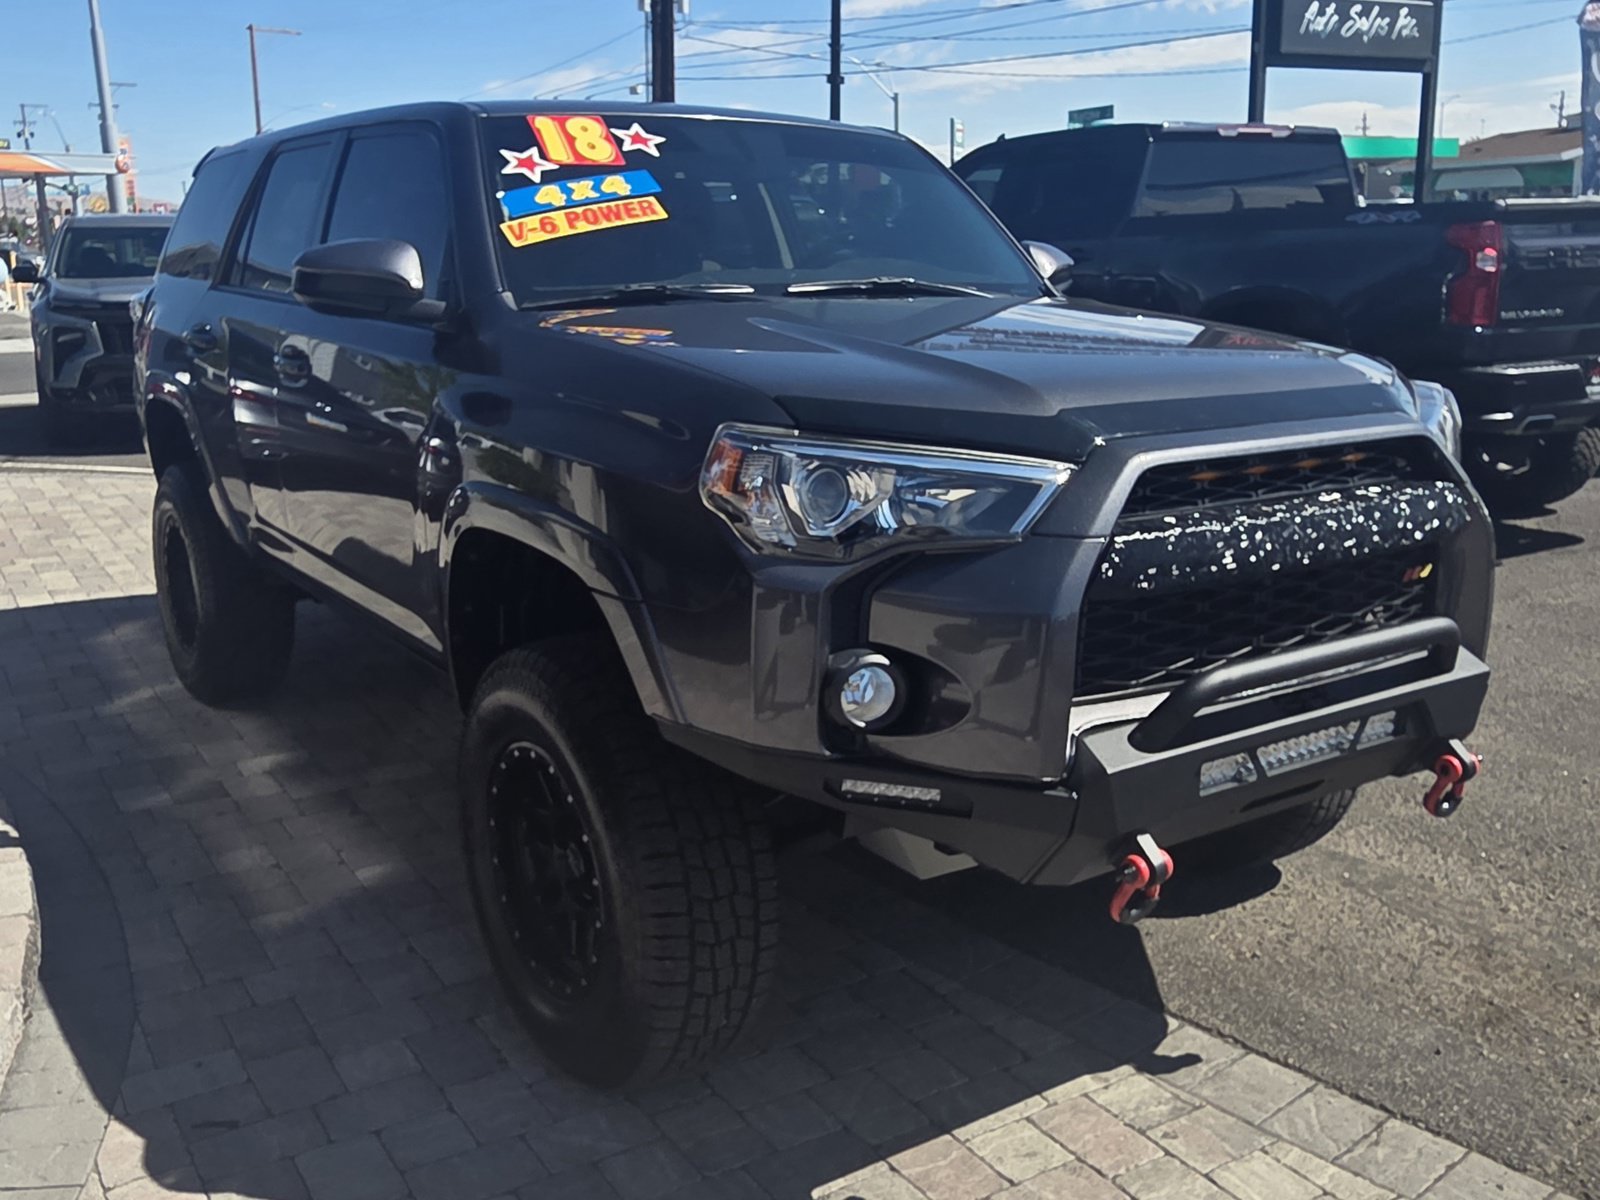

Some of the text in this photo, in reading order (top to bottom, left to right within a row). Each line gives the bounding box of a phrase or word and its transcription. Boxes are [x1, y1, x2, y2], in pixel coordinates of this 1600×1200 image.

[1340, 4, 1391, 43] Sales
[534, 116, 616, 163] 18
[507, 200, 658, 242] V-6 POWER
